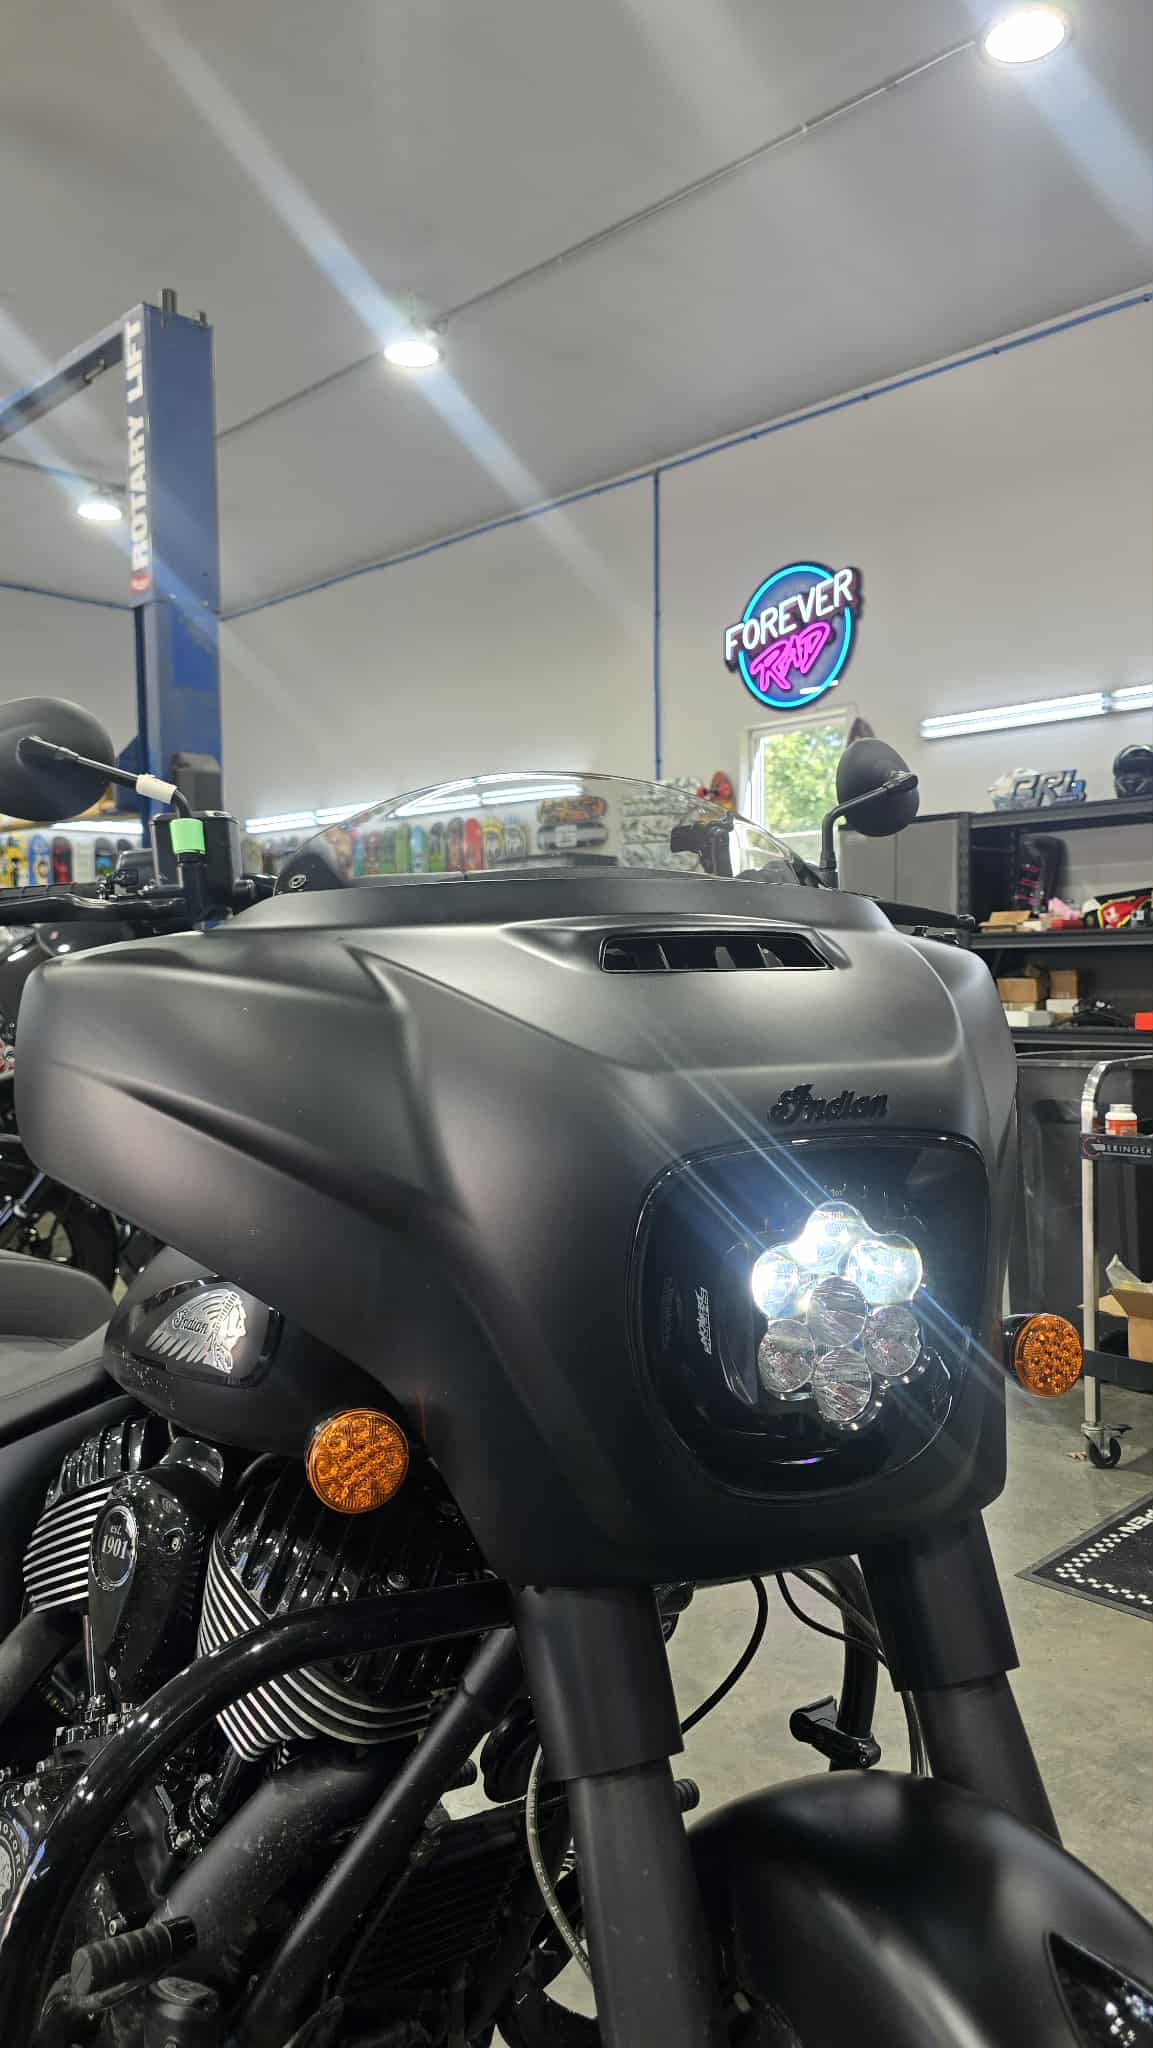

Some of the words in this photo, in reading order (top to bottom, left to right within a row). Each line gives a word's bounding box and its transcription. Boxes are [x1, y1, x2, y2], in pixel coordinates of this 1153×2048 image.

[125, 320, 144, 403] LIFT
[128, 415, 149, 571] ROTARY
[725, 568, 854, 661] FOREVER
[750, 621, 831, 692] RAD
[768, 1082, 888, 1121] Indian
[172, 1309, 209, 1335] Indian
[102, 1535, 128, 1559] 1901
